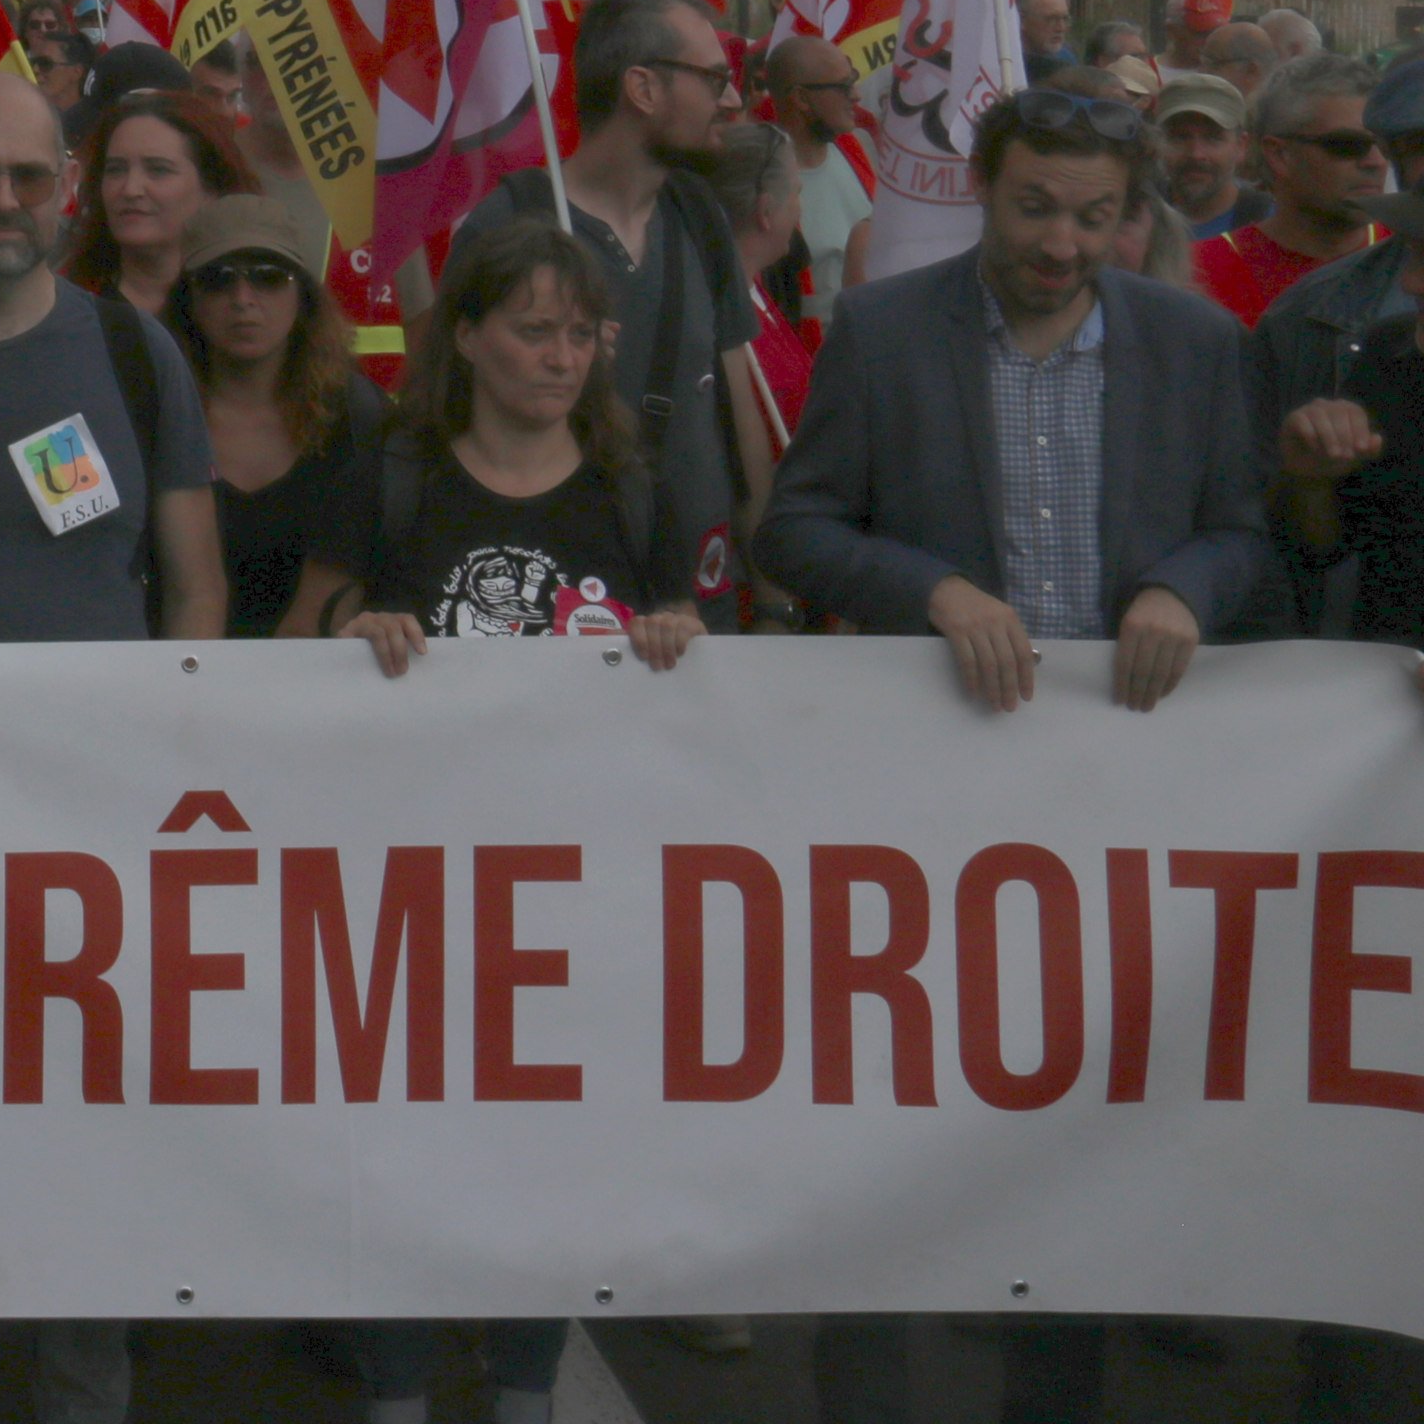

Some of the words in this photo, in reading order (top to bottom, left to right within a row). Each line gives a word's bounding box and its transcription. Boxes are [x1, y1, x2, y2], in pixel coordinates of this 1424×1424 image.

[60, 495, 109, 529] F.S.U.
[574, 613, 616, 627] Solidaires
[665, 845, 1424, 1111] DROITE
